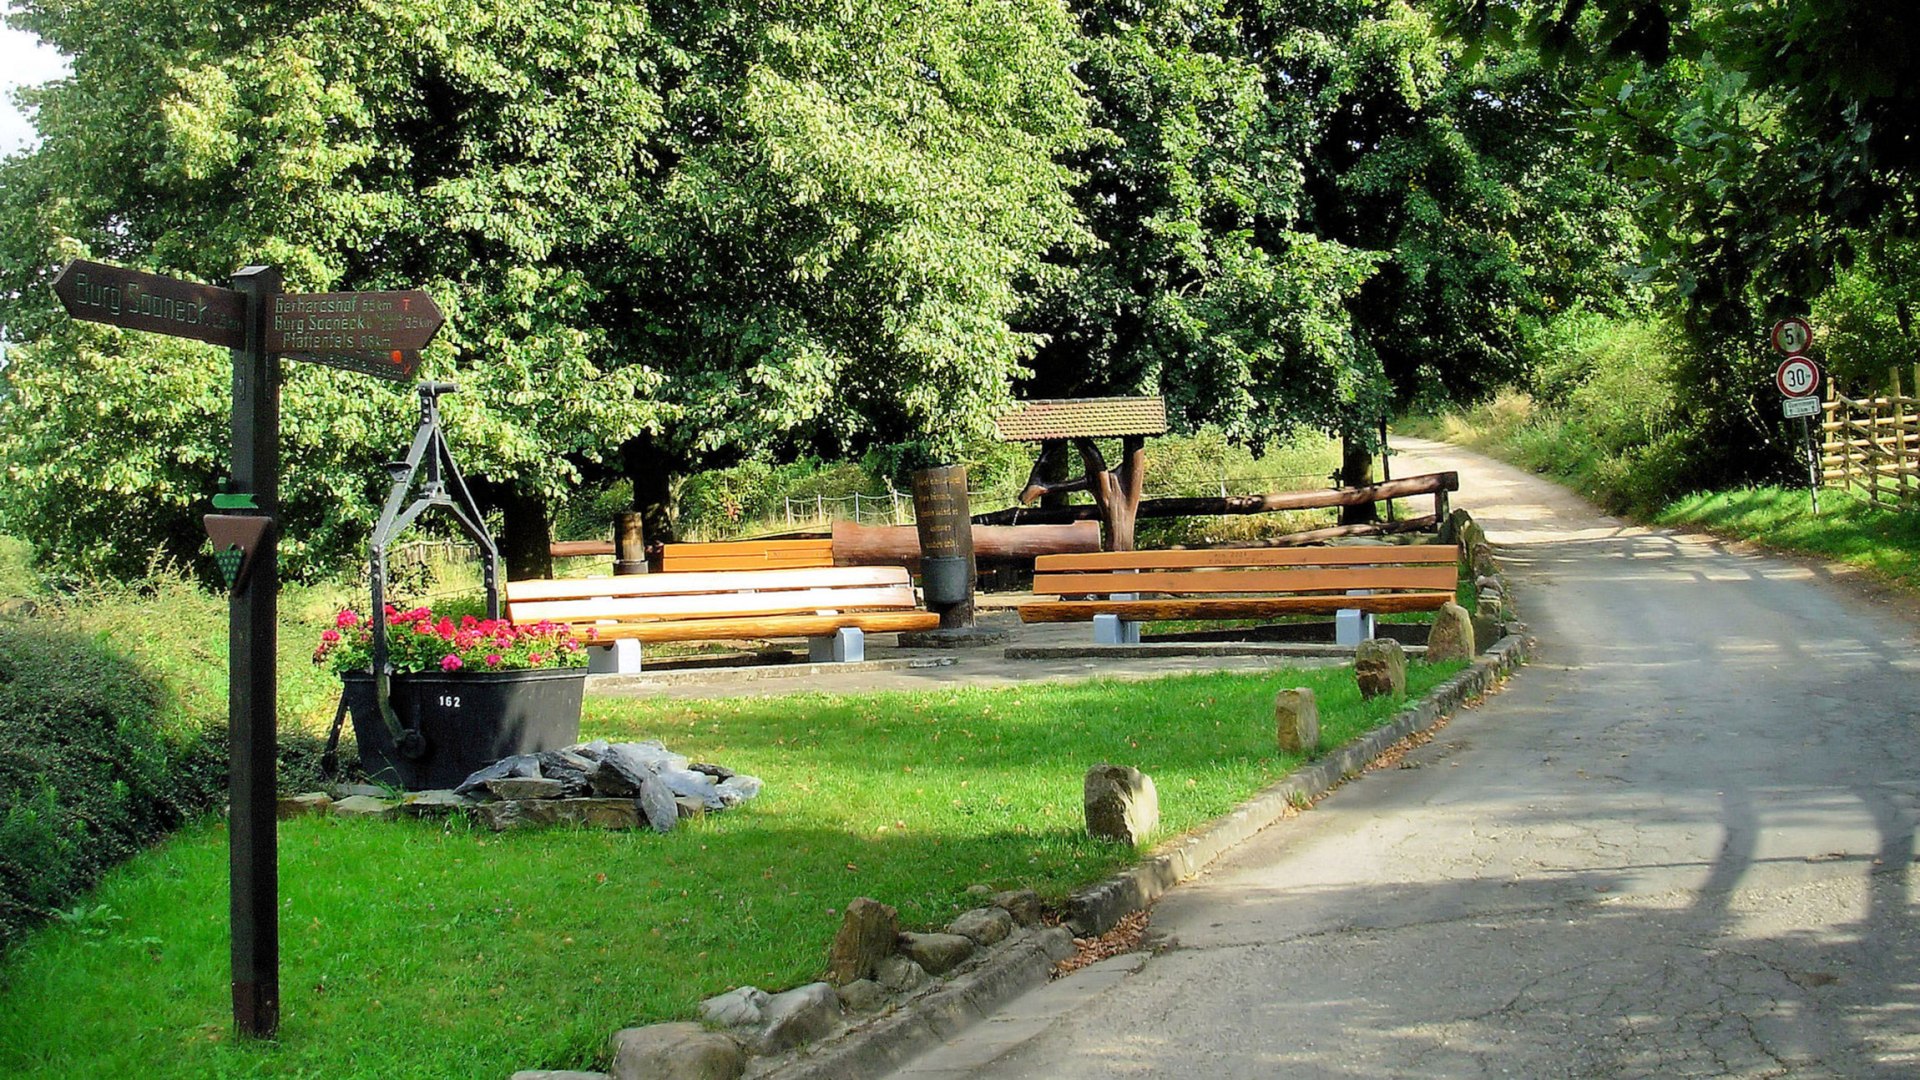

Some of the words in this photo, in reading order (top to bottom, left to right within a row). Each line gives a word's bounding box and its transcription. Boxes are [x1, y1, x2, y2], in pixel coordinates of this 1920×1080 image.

[76, 272, 121, 316] Burg
[127, 282, 208, 325] Sooneck
[274, 314, 304, 334] Burg
[1787, 368, 1805, 388] 30
[439, 695, 461, 708] 162
